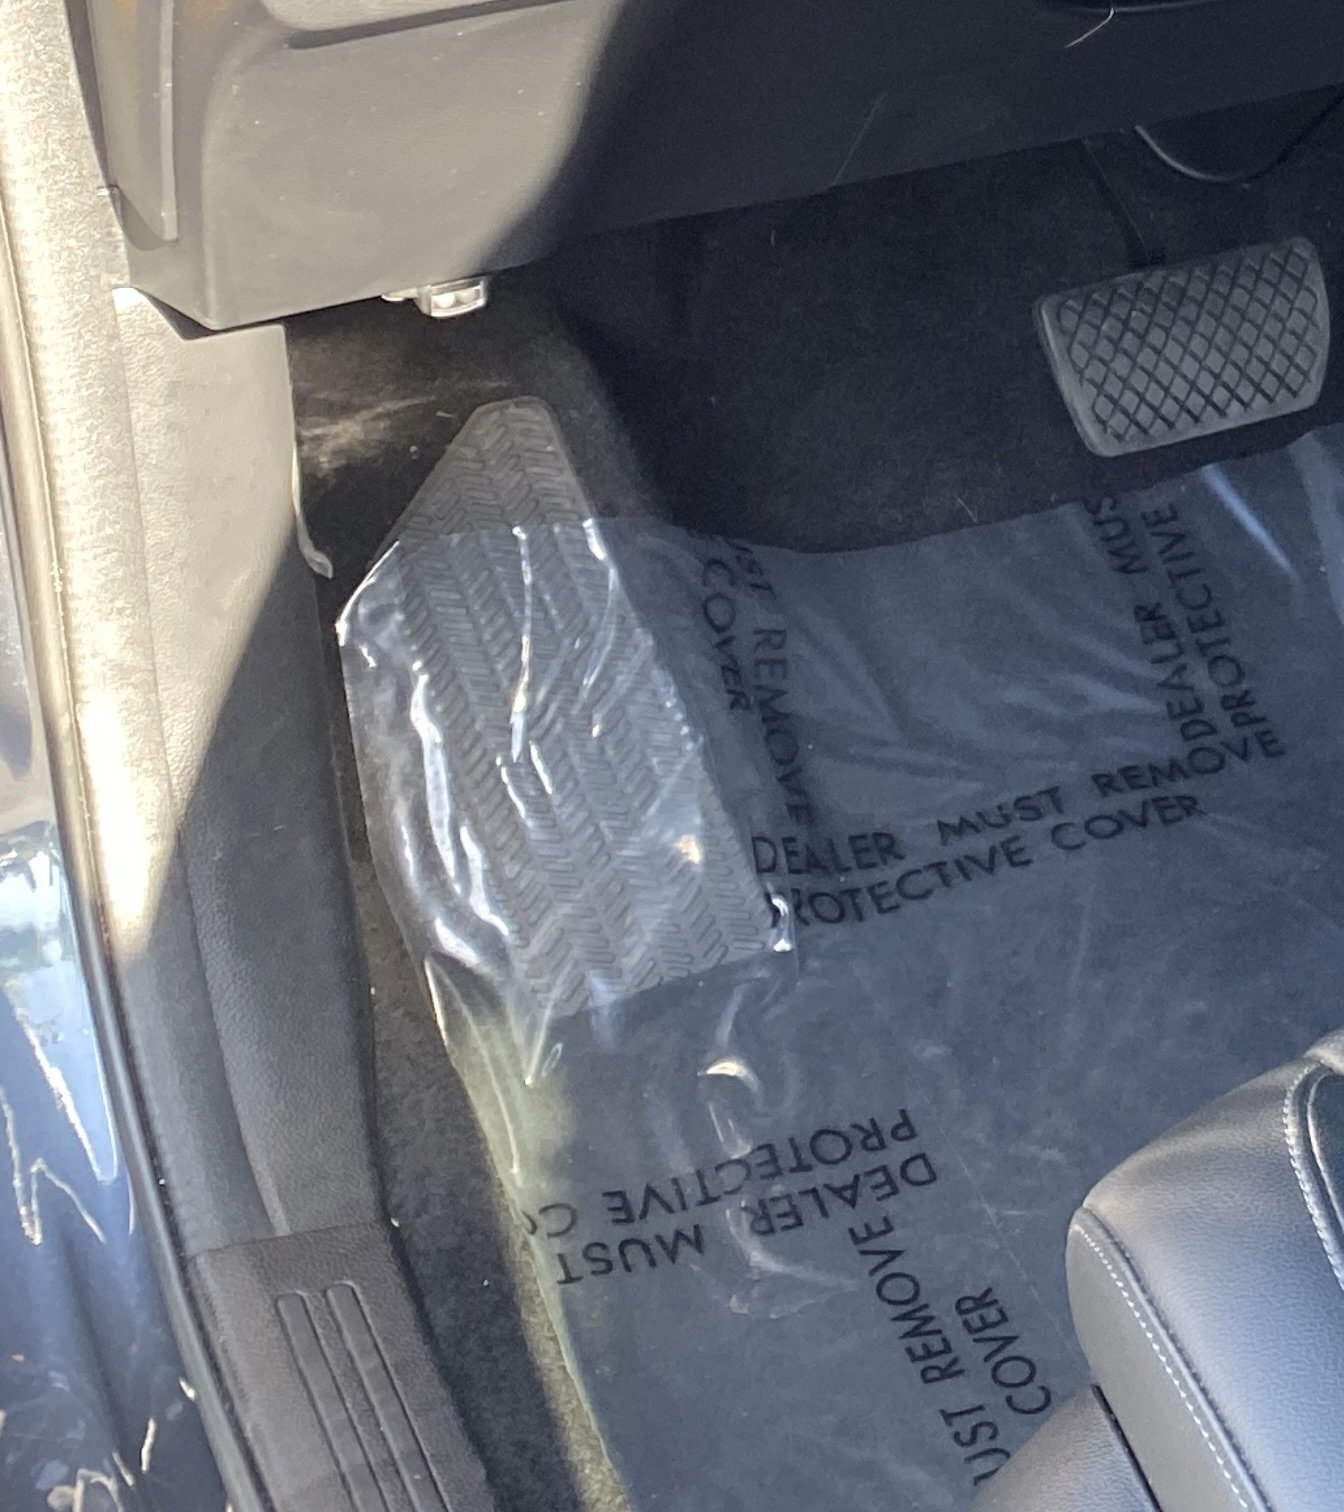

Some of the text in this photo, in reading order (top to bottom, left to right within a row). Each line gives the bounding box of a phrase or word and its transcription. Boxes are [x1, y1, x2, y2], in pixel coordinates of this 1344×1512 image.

[1133, 601, 1219, 743] DEALER
[1140, 502, 1268, 728] PROTECTIVE
[751, 728, 1287, 875] DEALER MUST REMOVE
[1050, 794, 1208, 852] COVER
[555, 1151, 939, 1286] DEALER MUST
[601, 1108, 919, 1226] PROTECTIVE
[847, 1215, 966, 1385] REMOVE
[954, 1286, 1052, 1416] COVER
